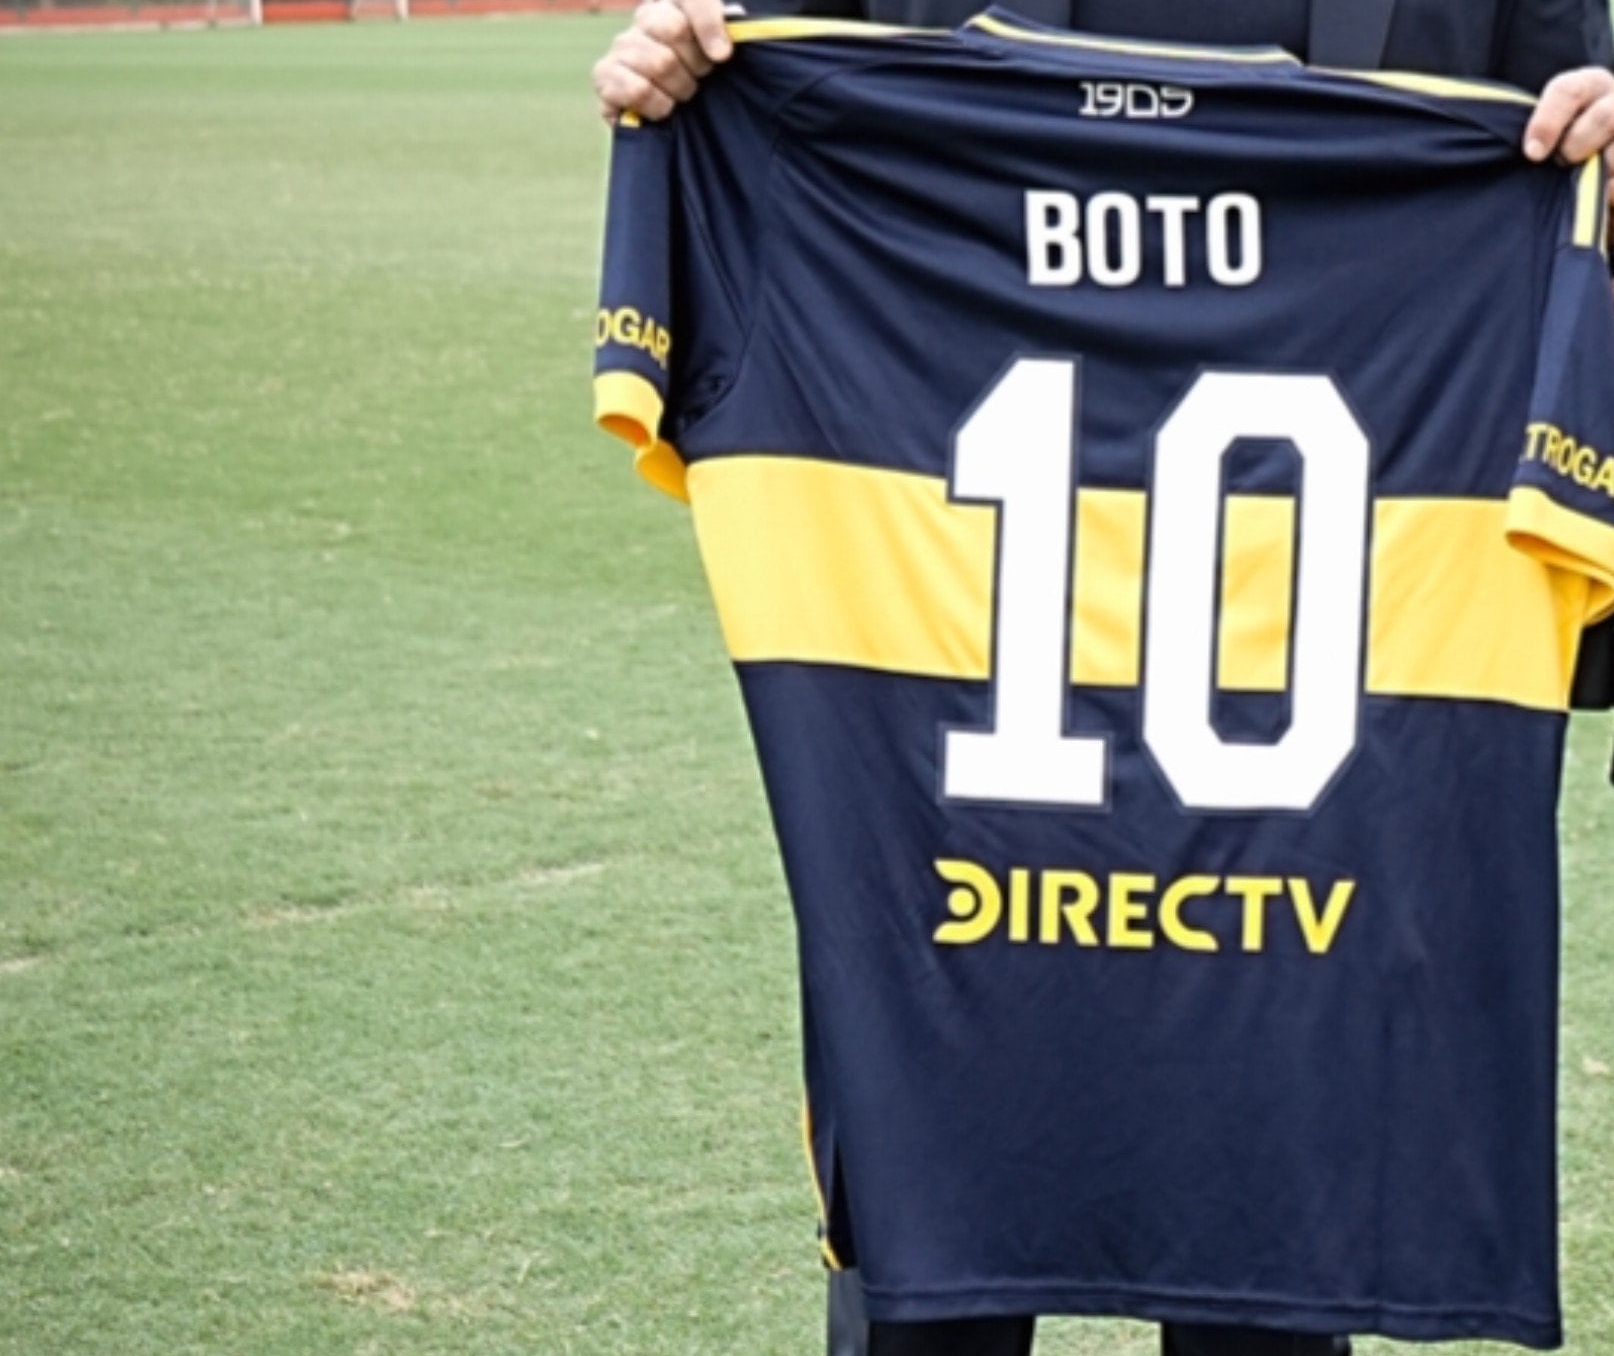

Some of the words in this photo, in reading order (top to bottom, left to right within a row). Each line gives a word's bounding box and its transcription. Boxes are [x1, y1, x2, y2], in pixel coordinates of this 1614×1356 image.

[1025, 190, 1262, 286] BOTO
[944, 359, 1369, 809] 10
[933, 858, 1356, 954] DIRECTV
